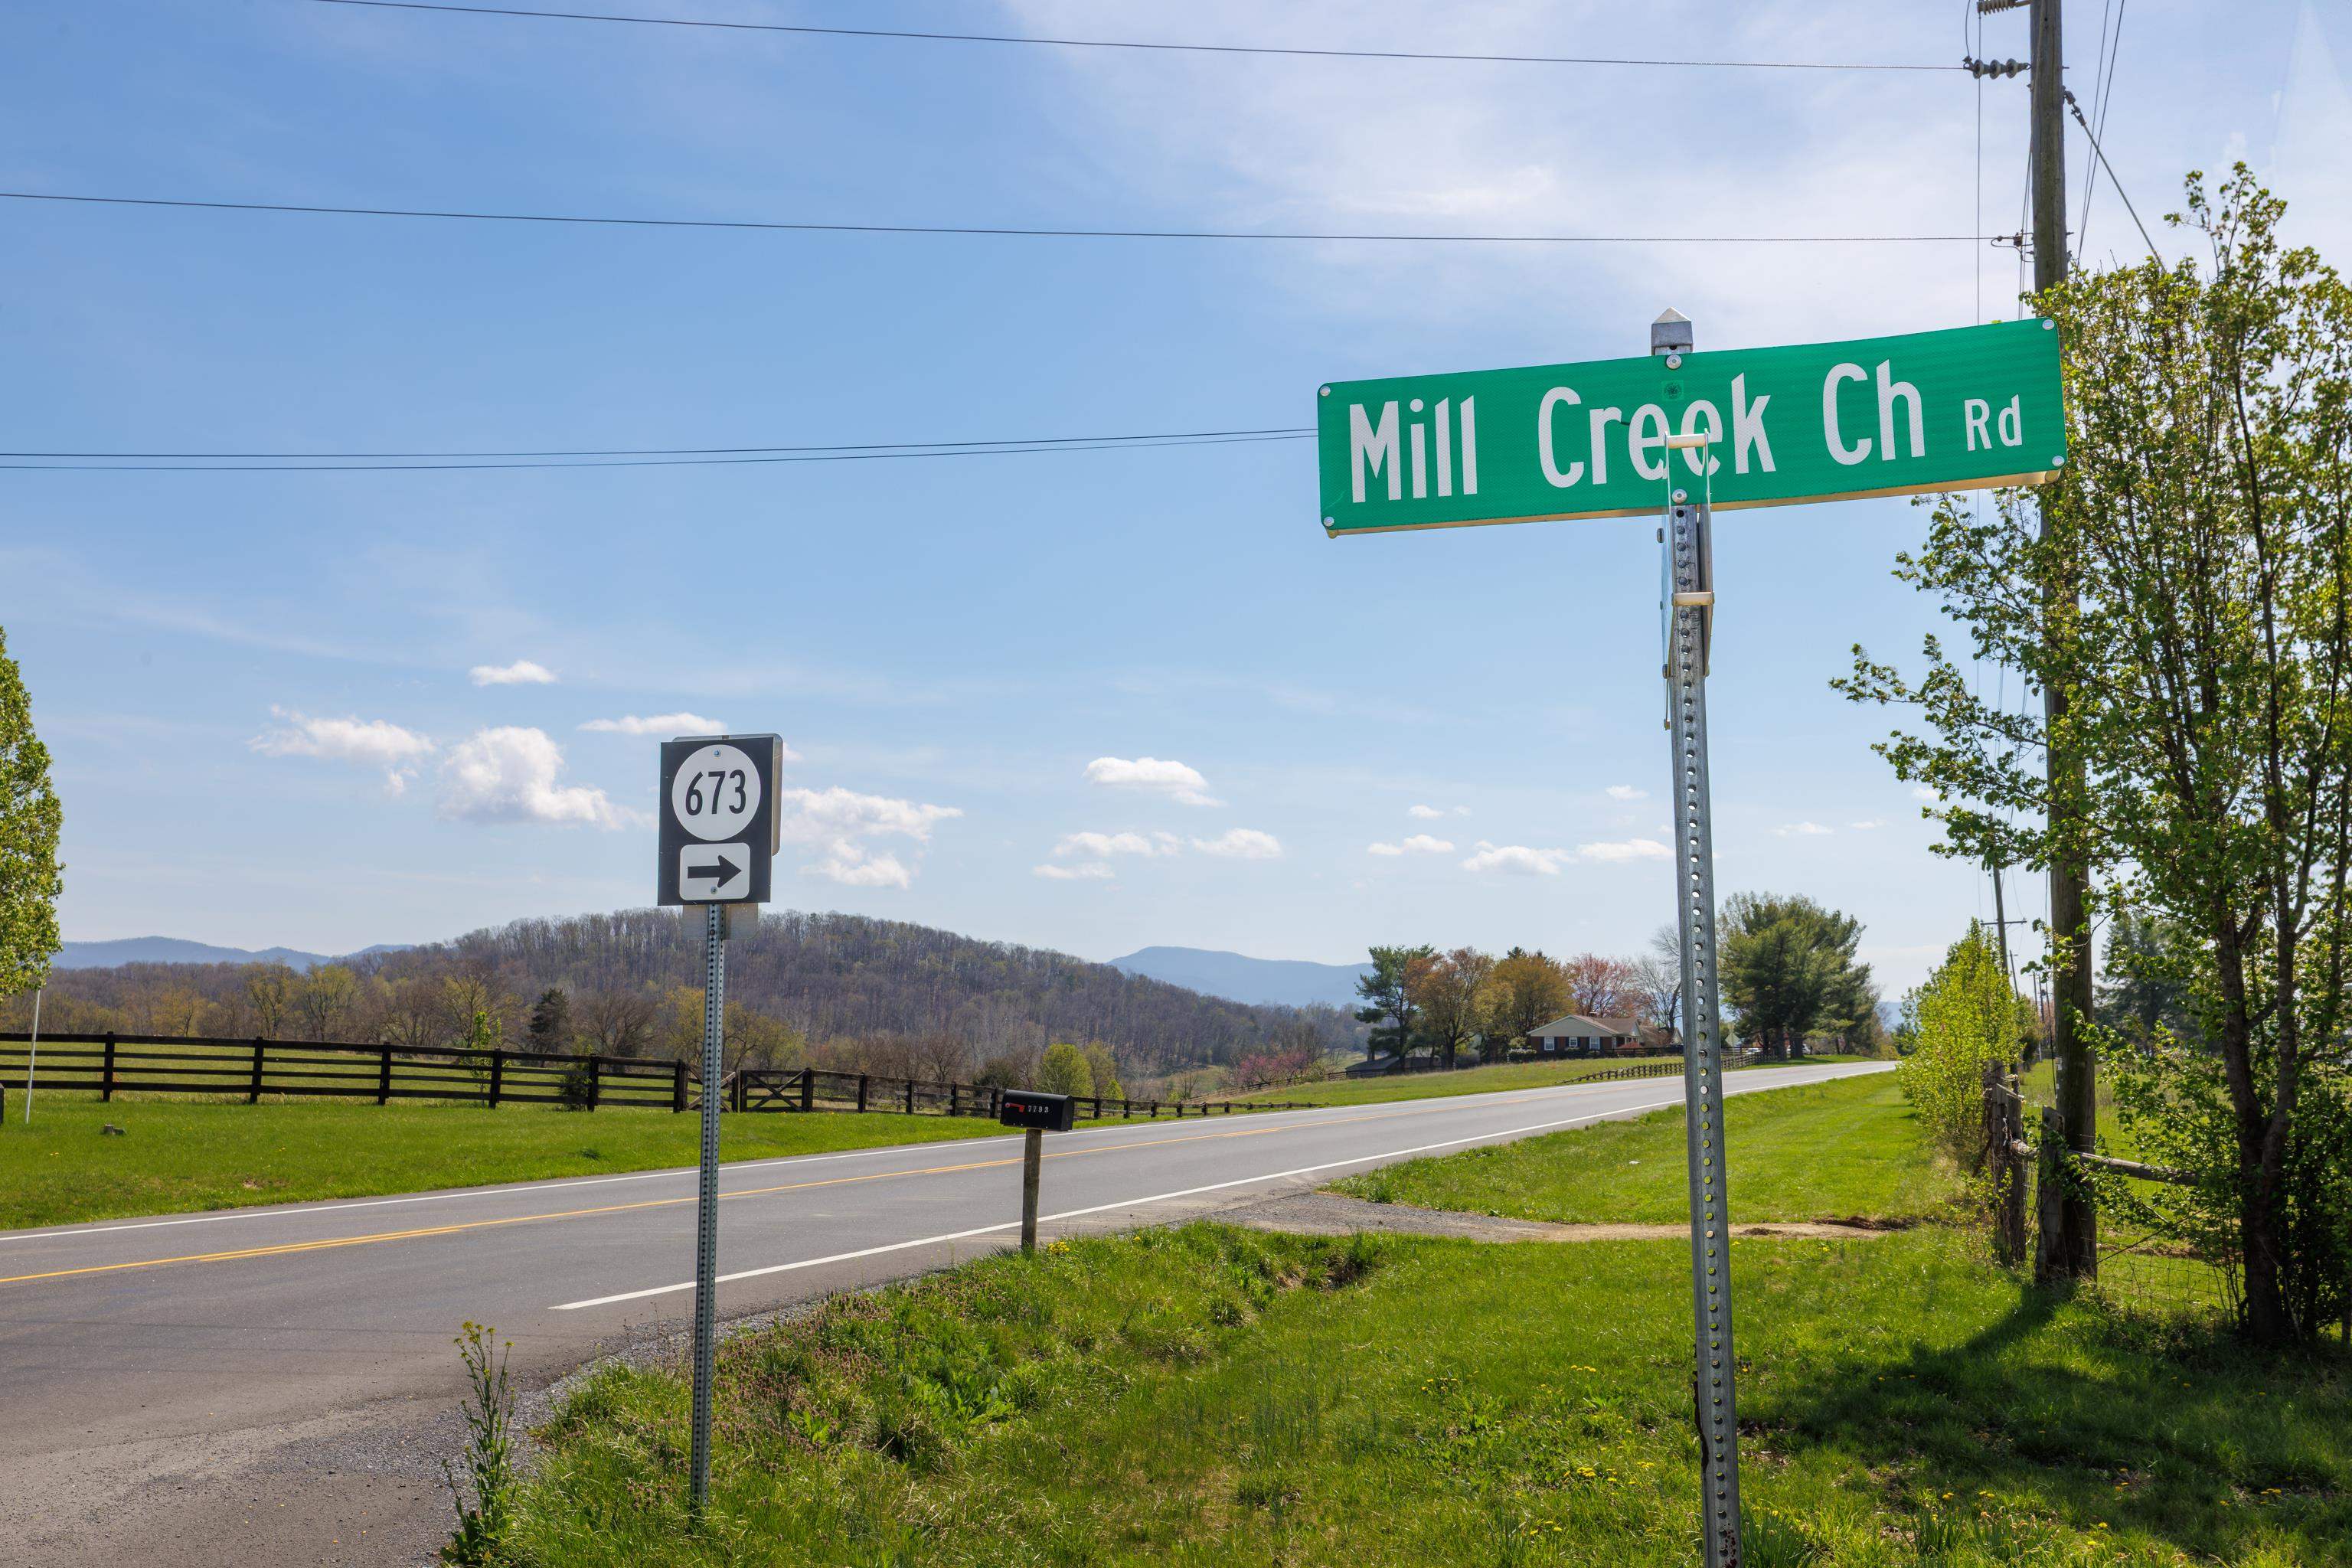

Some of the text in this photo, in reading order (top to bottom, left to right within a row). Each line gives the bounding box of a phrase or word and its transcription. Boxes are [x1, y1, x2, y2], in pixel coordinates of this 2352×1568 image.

[1349, 359, 2023, 503] Mill Creek Ch Rd
[685, 769, 746, 816] 673
